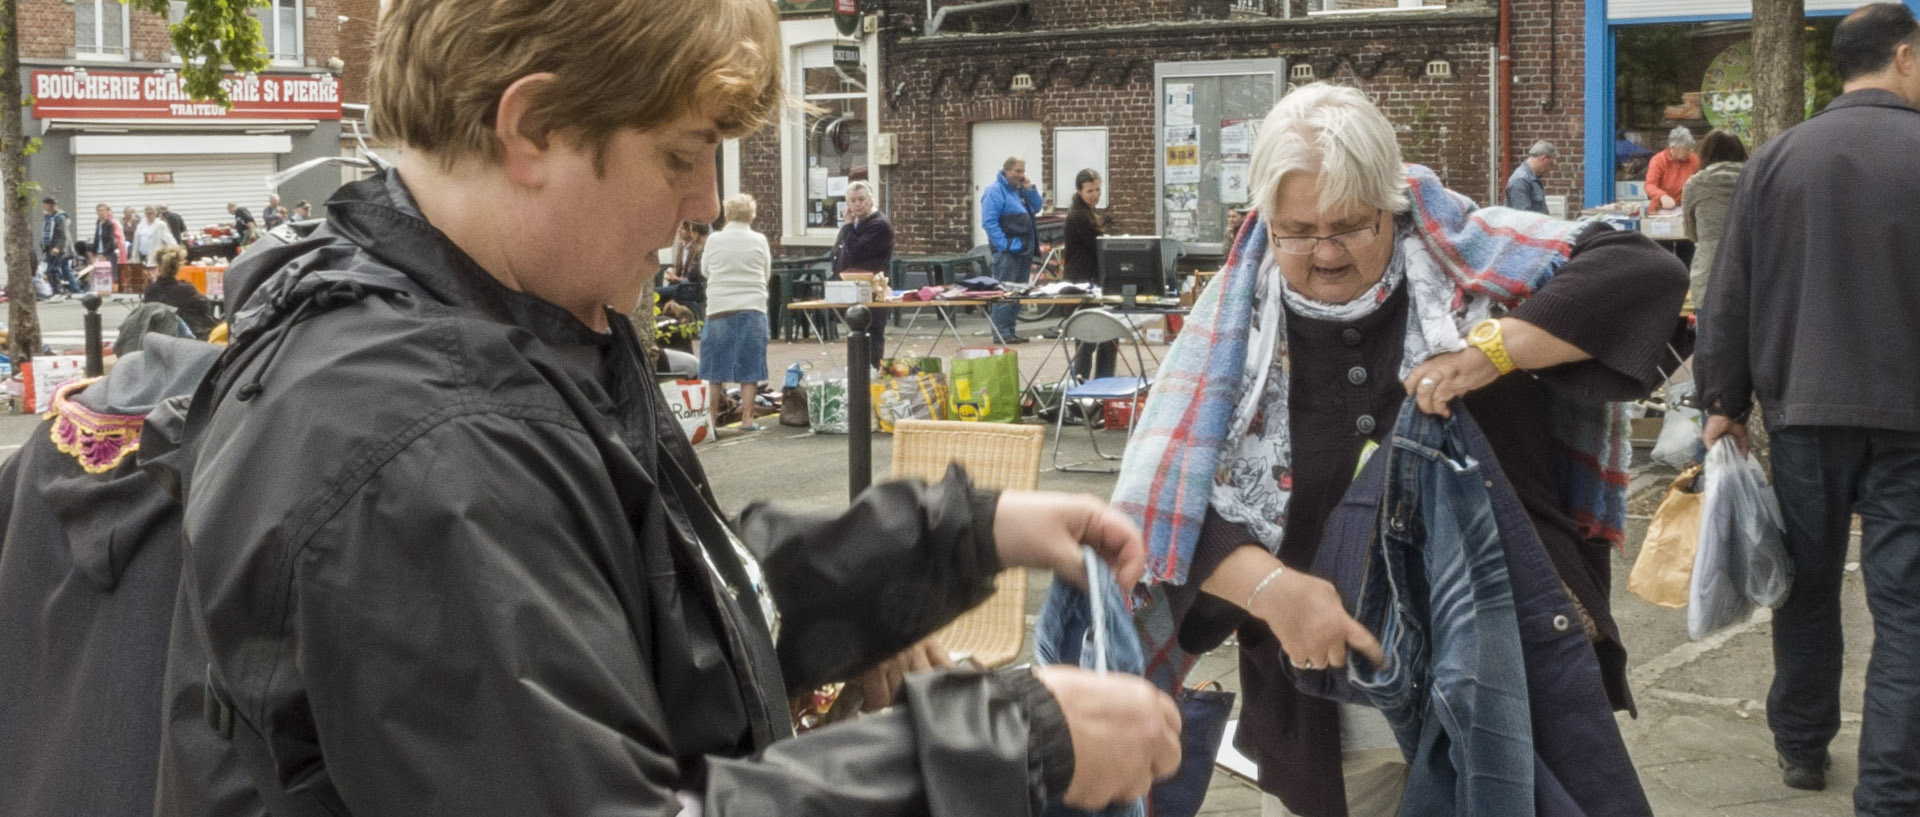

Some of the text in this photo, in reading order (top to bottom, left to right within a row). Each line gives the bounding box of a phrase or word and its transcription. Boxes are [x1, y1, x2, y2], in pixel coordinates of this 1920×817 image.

[37, 74, 140, 100] BOUCHERIE
[263, 79, 280, 102] St
[170, 103, 226, 116] TRAITEUR
